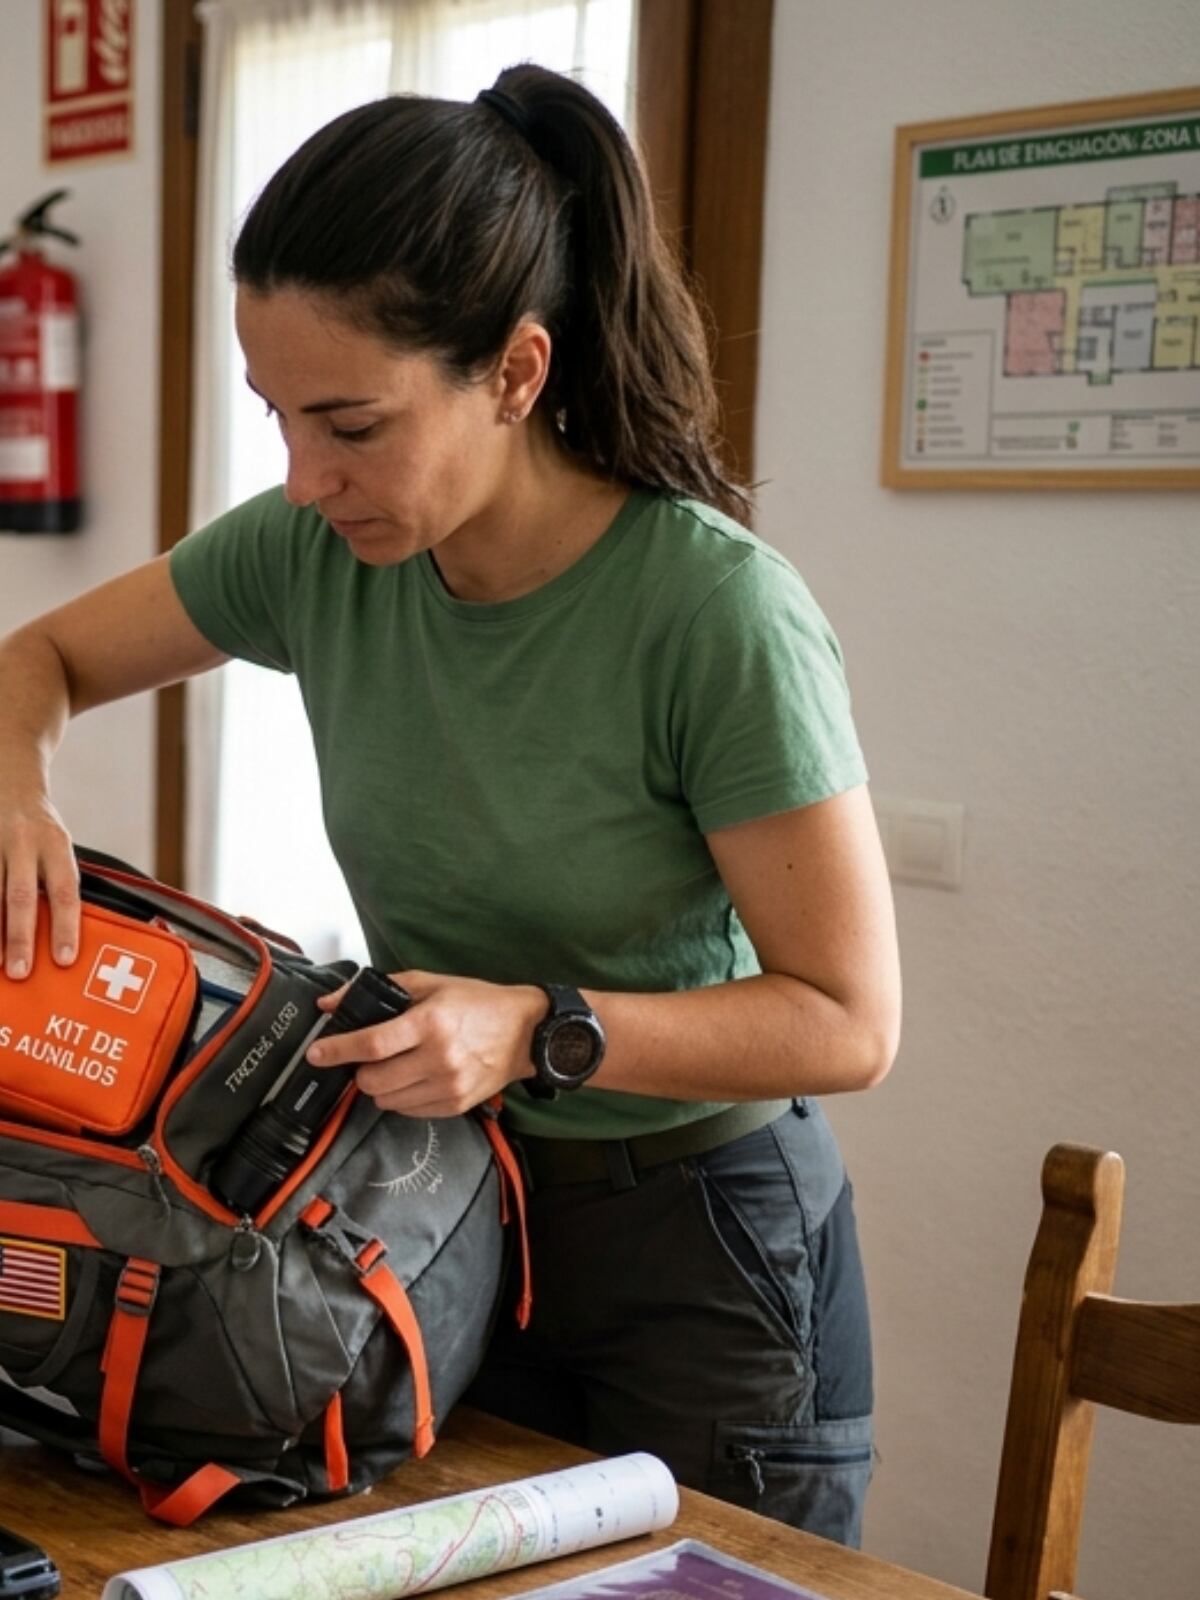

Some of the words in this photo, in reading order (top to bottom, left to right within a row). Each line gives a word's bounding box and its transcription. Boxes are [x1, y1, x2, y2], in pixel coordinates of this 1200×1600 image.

[1141, 126, 1192, 149] ZONA
[45, 1015, 89, 1044] KIT
[90, 1031, 128, 1061] DE
